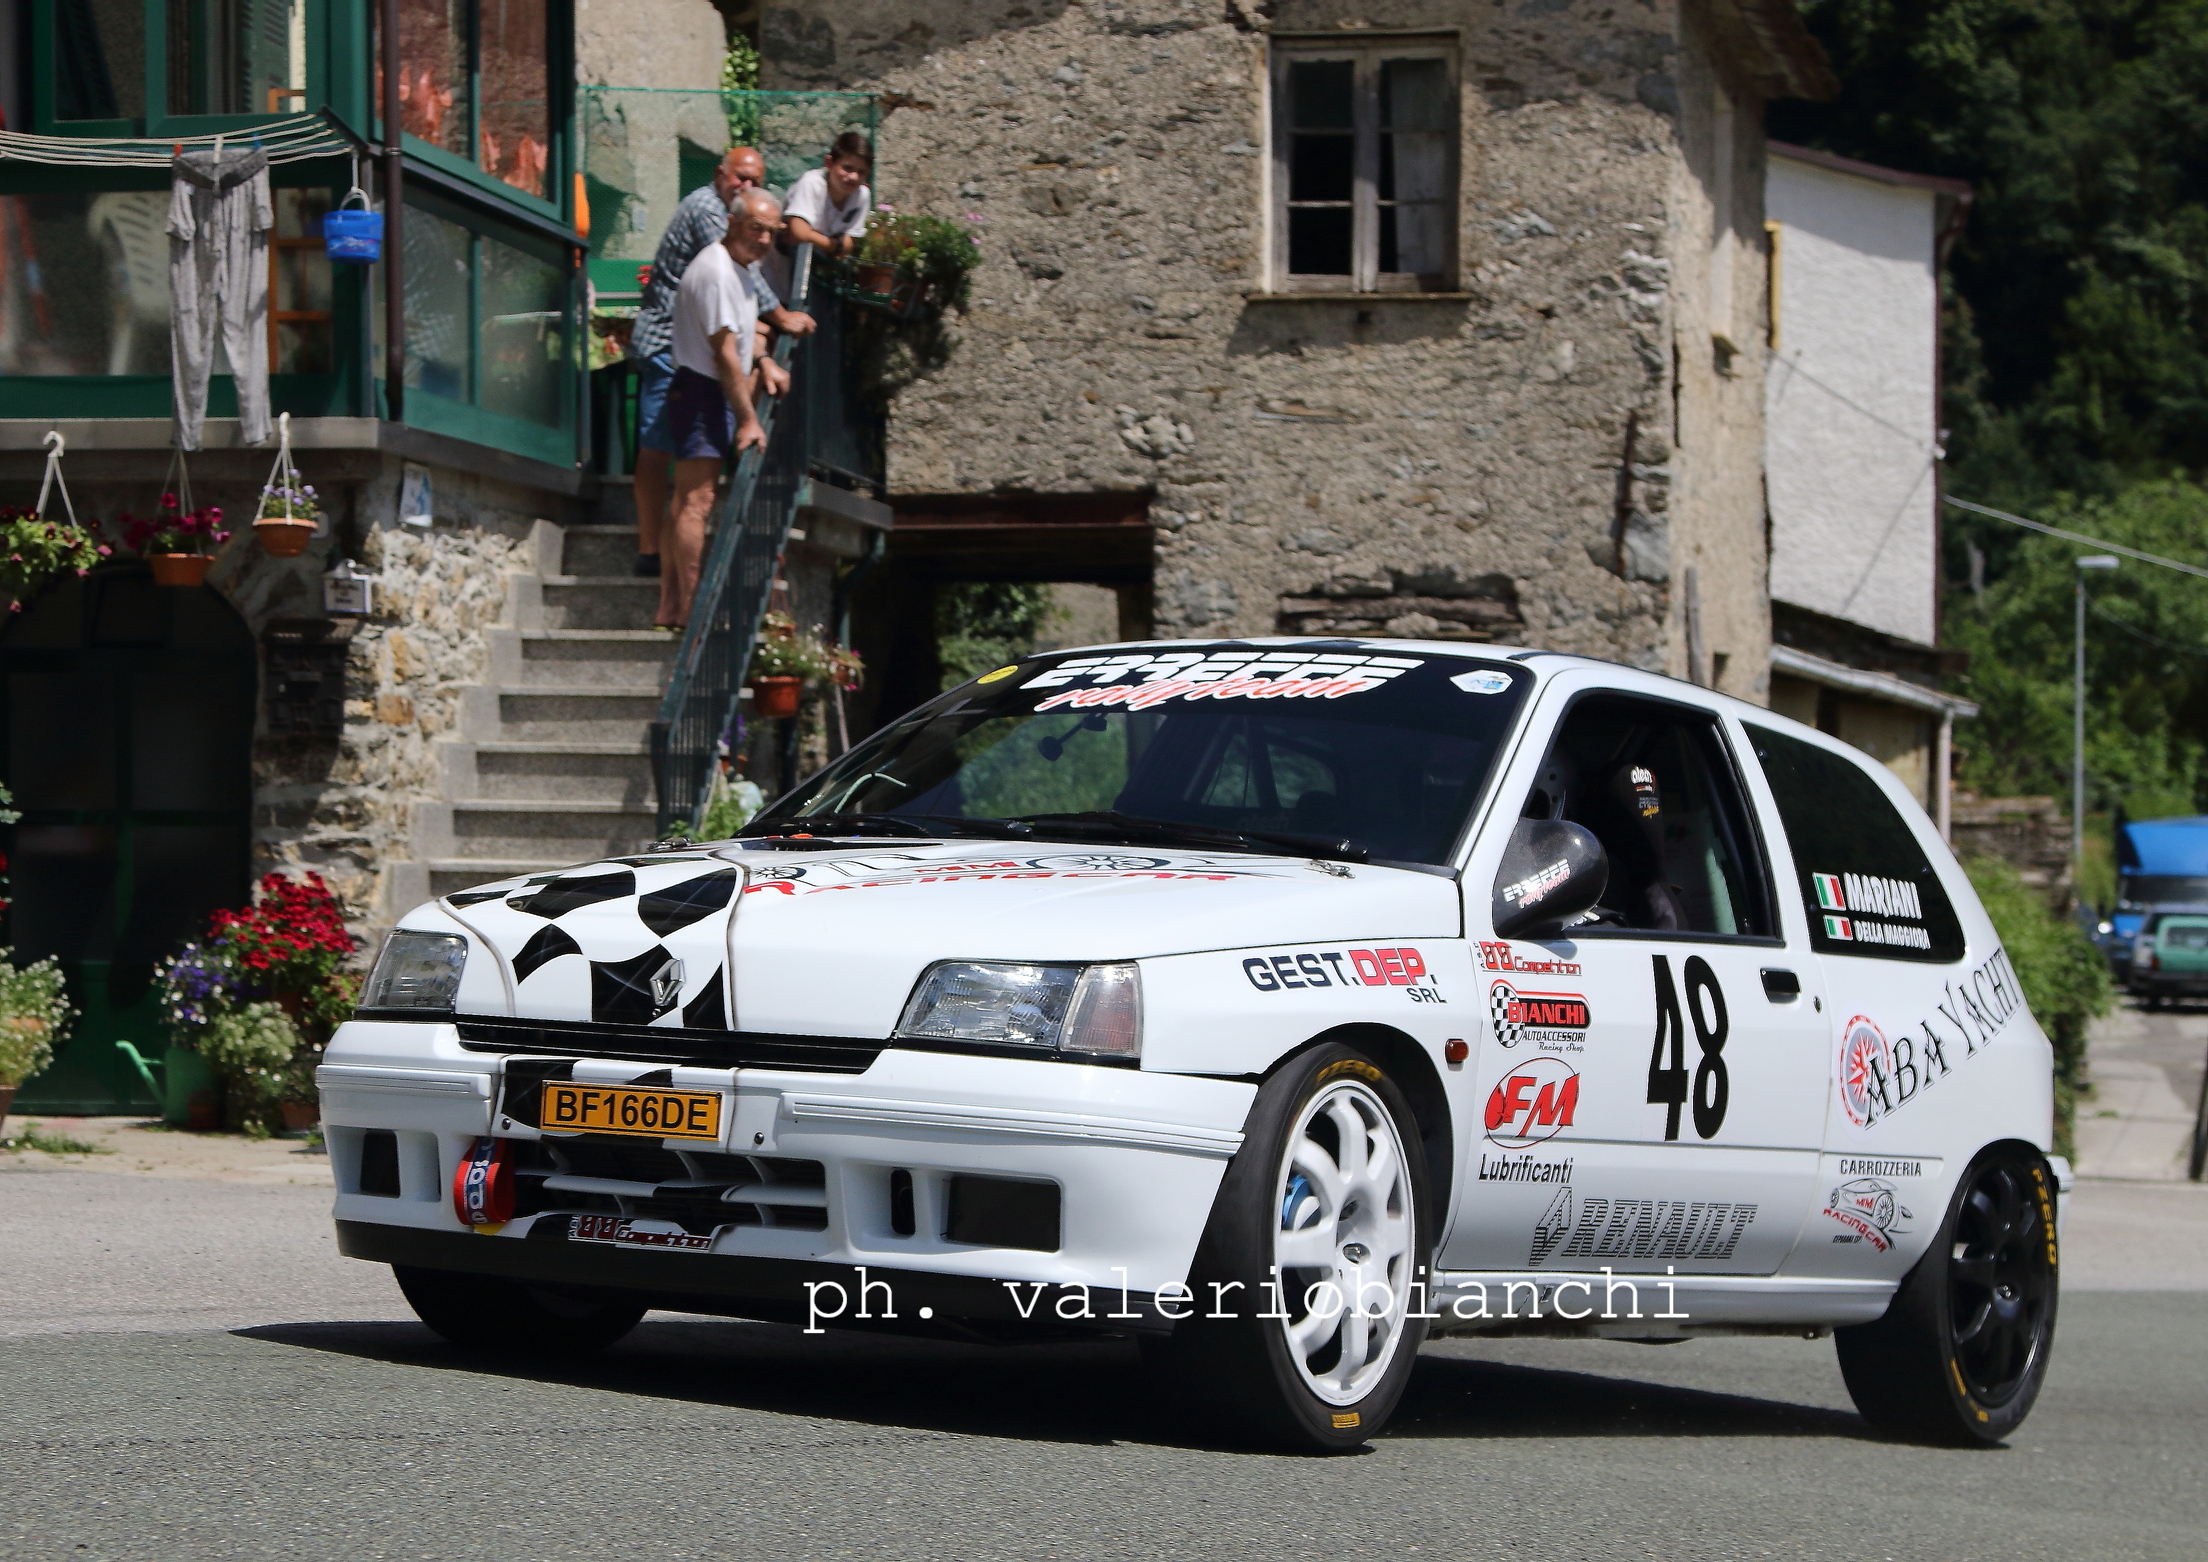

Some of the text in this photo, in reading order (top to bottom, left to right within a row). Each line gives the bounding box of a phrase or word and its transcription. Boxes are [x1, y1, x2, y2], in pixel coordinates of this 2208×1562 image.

[1019, 652, 1425, 692] ERREFFE
[1844, 872, 1923, 920] MARIANI
[1853, 920, 1885, 944] DELLA
[1514, 955, 1582, 975] Competition
[1407, 987, 1447, 1003] SRL
[1507, 1001, 1586, 1025] BIANCHI
[1522, 1030, 1587, 1042] AUTOACCESSORI
[1538, 1042, 1585, 1053] Racing Shop
[1647, 954, 1730, 1141] 48
[1865, 946, 2022, 1131] ABA YACHT
[555, 1090, 709, 1131] BF166DE
[1501, 1072, 1580, 1138] FM
[1479, 1154, 1574, 1184] Lubrificanti
[1840, 1159, 1922, 1177] CARROZZERIA
[1562, 1198, 1758, 1260] RENAULT
